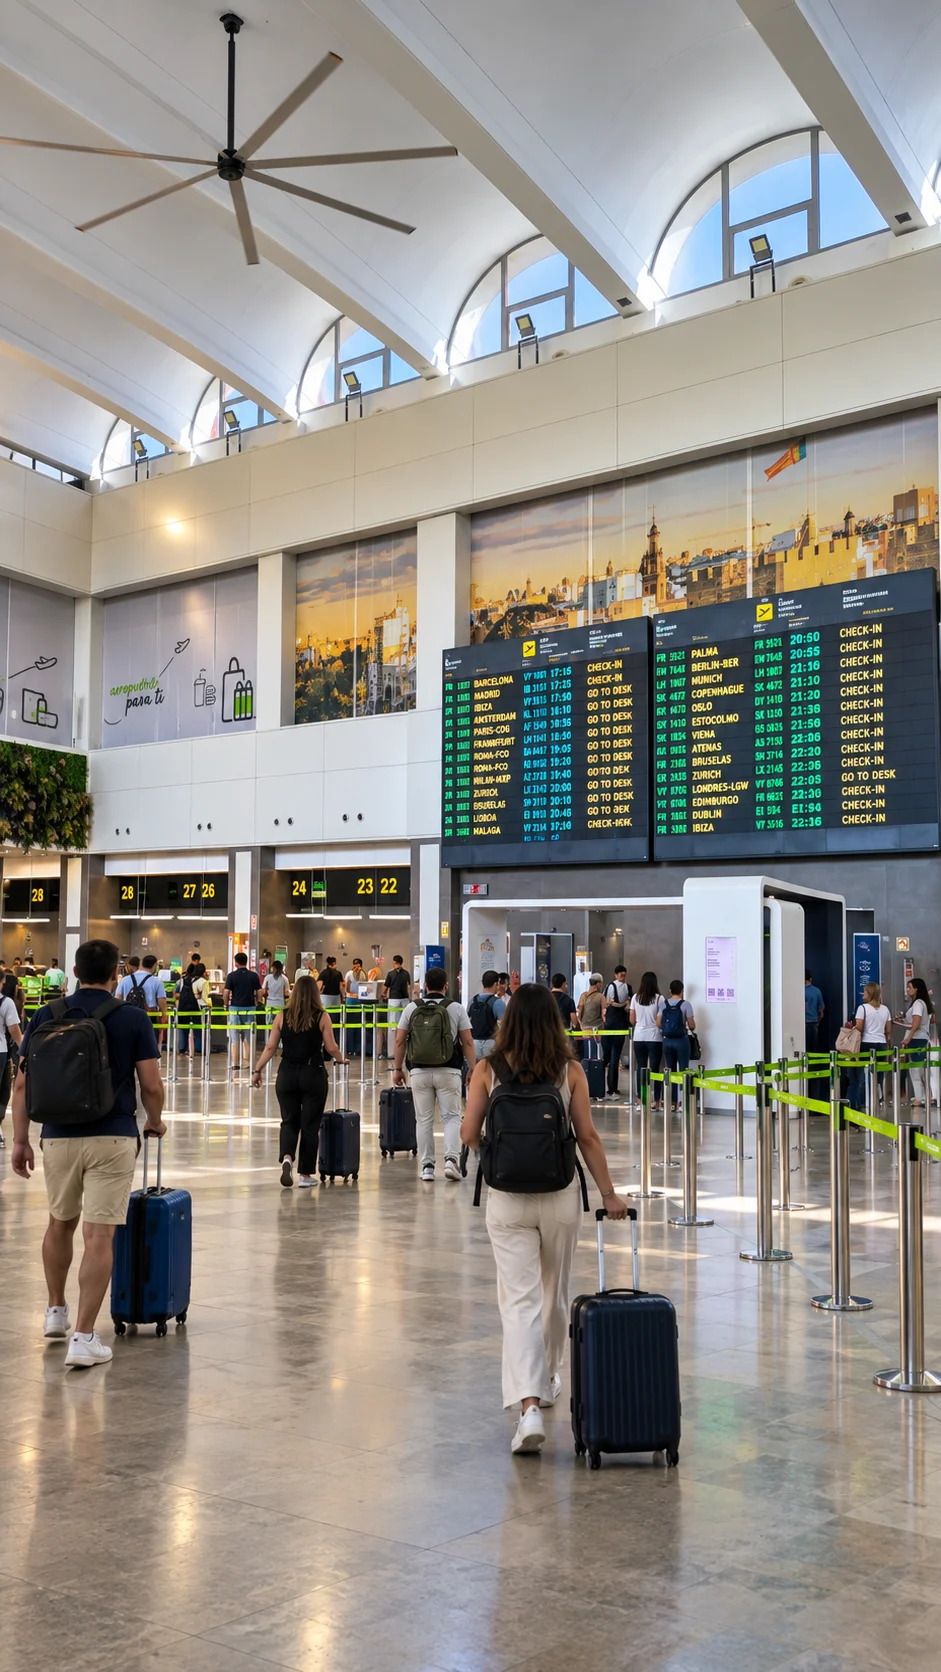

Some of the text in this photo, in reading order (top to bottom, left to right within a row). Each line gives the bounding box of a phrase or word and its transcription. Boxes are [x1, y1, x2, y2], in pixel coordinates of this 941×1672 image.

[840, 624, 882, 637] CHECK-IN
[755, 640, 764, 649] FR
[840, 639, 882, 652] CHECK-IN
[692, 647, 718, 658] PALMA
[692, 658, 738, 672] BERLIN-BER
[840, 654, 882, 667] CHECK-IN
[755, 668, 764, 678] LH
[840, 669, 882, 682] CHECK-IN
[657, 680, 666, 689] LH
[692, 674, 722, 685] MUNICH
[474, 690, 500, 700] MADRID
[588, 689, 598, 698] GO
[601, 688, 611, 696] TO
[692, 684, 744, 698] COPENHAGUE
[840, 684, 882, 696] CHECK-IN
[791, 690, 820, 702] 21:20
[587, 702, 598, 710] GO
[601, 700, 611, 709] TO
[692, 702, 712, 712] OSLO
[841, 698, 883, 710] CHECK-IN
[587, 715, 598, 724] GO
[600, 714, 611, 722] TO
[692, 714, 738, 726] ESTOCOLMO
[841, 713, 883, 724] CHECK-IN
[587, 728, 598, 737] GO
[601, 727, 610, 735] TO
[692, 730, 715, 739] VIENA
[841, 727, 883, 739] CHECK-IN
[588, 742, 598, 750] GO
[601, 740, 611, 748] TO
[692, 742, 722, 753] ATENAS
[841, 742, 884, 754] CHECK-IN
[791, 746, 821, 758] 22:20
[588, 754, 598, 763] GO
[601, 754, 611, 762] TO
[692, 755, 731, 766] BRUSELAS
[842, 756, 884, 767] CHECK-IN
[588, 768, 599, 776] GO
[599, 767, 611, 775] TO
[692, 770, 721, 780] ZURICH
[756, 766, 765, 774] LX
[842, 769, 896, 782] GO TO DESK
[588, 781, 598, 789] GO
[601, 780, 611, 788] TO
[692, 781, 748, 793] LONDRES-LGW
[657, 787, 667, 795] VY
[842, 785, 884, 796] CHECK-IN
[588, 794, 598, 802] GO
[601, 793, 611, 801] TO
[693, 796, 738, 806] EDIMBURGO
[842, 799, 885, 810] CHECK-IN
[588, 806, 611, 815] GO TO
[693, 810, 721, 819] DUBLIN
[842, 814, 885, 824] CHECK-IN
[693, 824, 714, 832] IBIZA
[183, 884, 196, 898] 27
[202, 884, 214, 897] 26
[293, 881, 306, 895] 24
[358, 878, 373, 894] 23
[381, 878, 397, 893] 22
[32, 888, 43, 902] 28
[122, 886, 133, 899] 28
